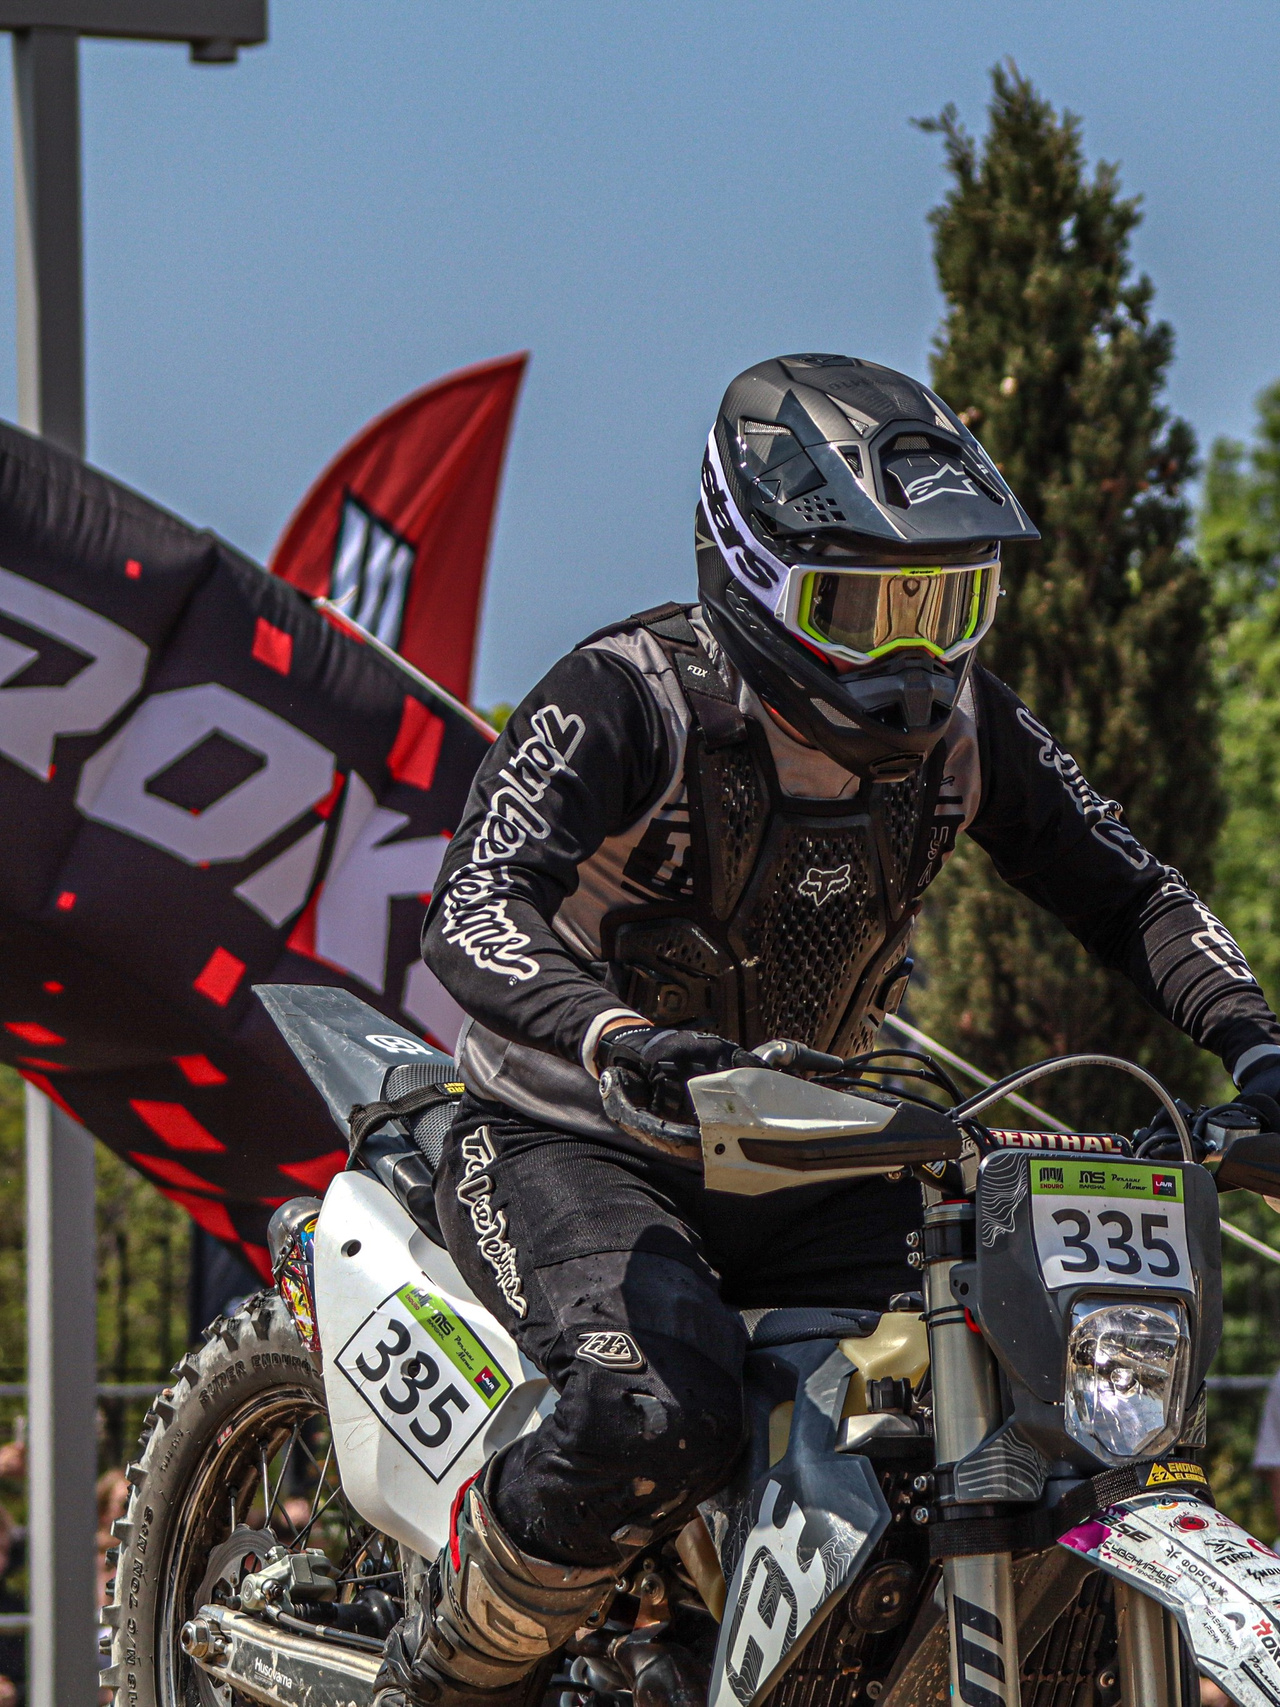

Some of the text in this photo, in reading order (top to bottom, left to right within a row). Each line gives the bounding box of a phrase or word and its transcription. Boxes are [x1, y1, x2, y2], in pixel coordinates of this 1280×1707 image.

[686, 663, 709, 679] FOX
[1155, 1180, 1173, 1188] LAVR
[1051, 1208, 1180, 1278] 335
[355, 1318, 471, 1448] 335
[1101, 1540, 1178, 1585] СУВЕНИРНЫЕ
[1181, 1554, 1230, 1599] ФОРСАЖ
